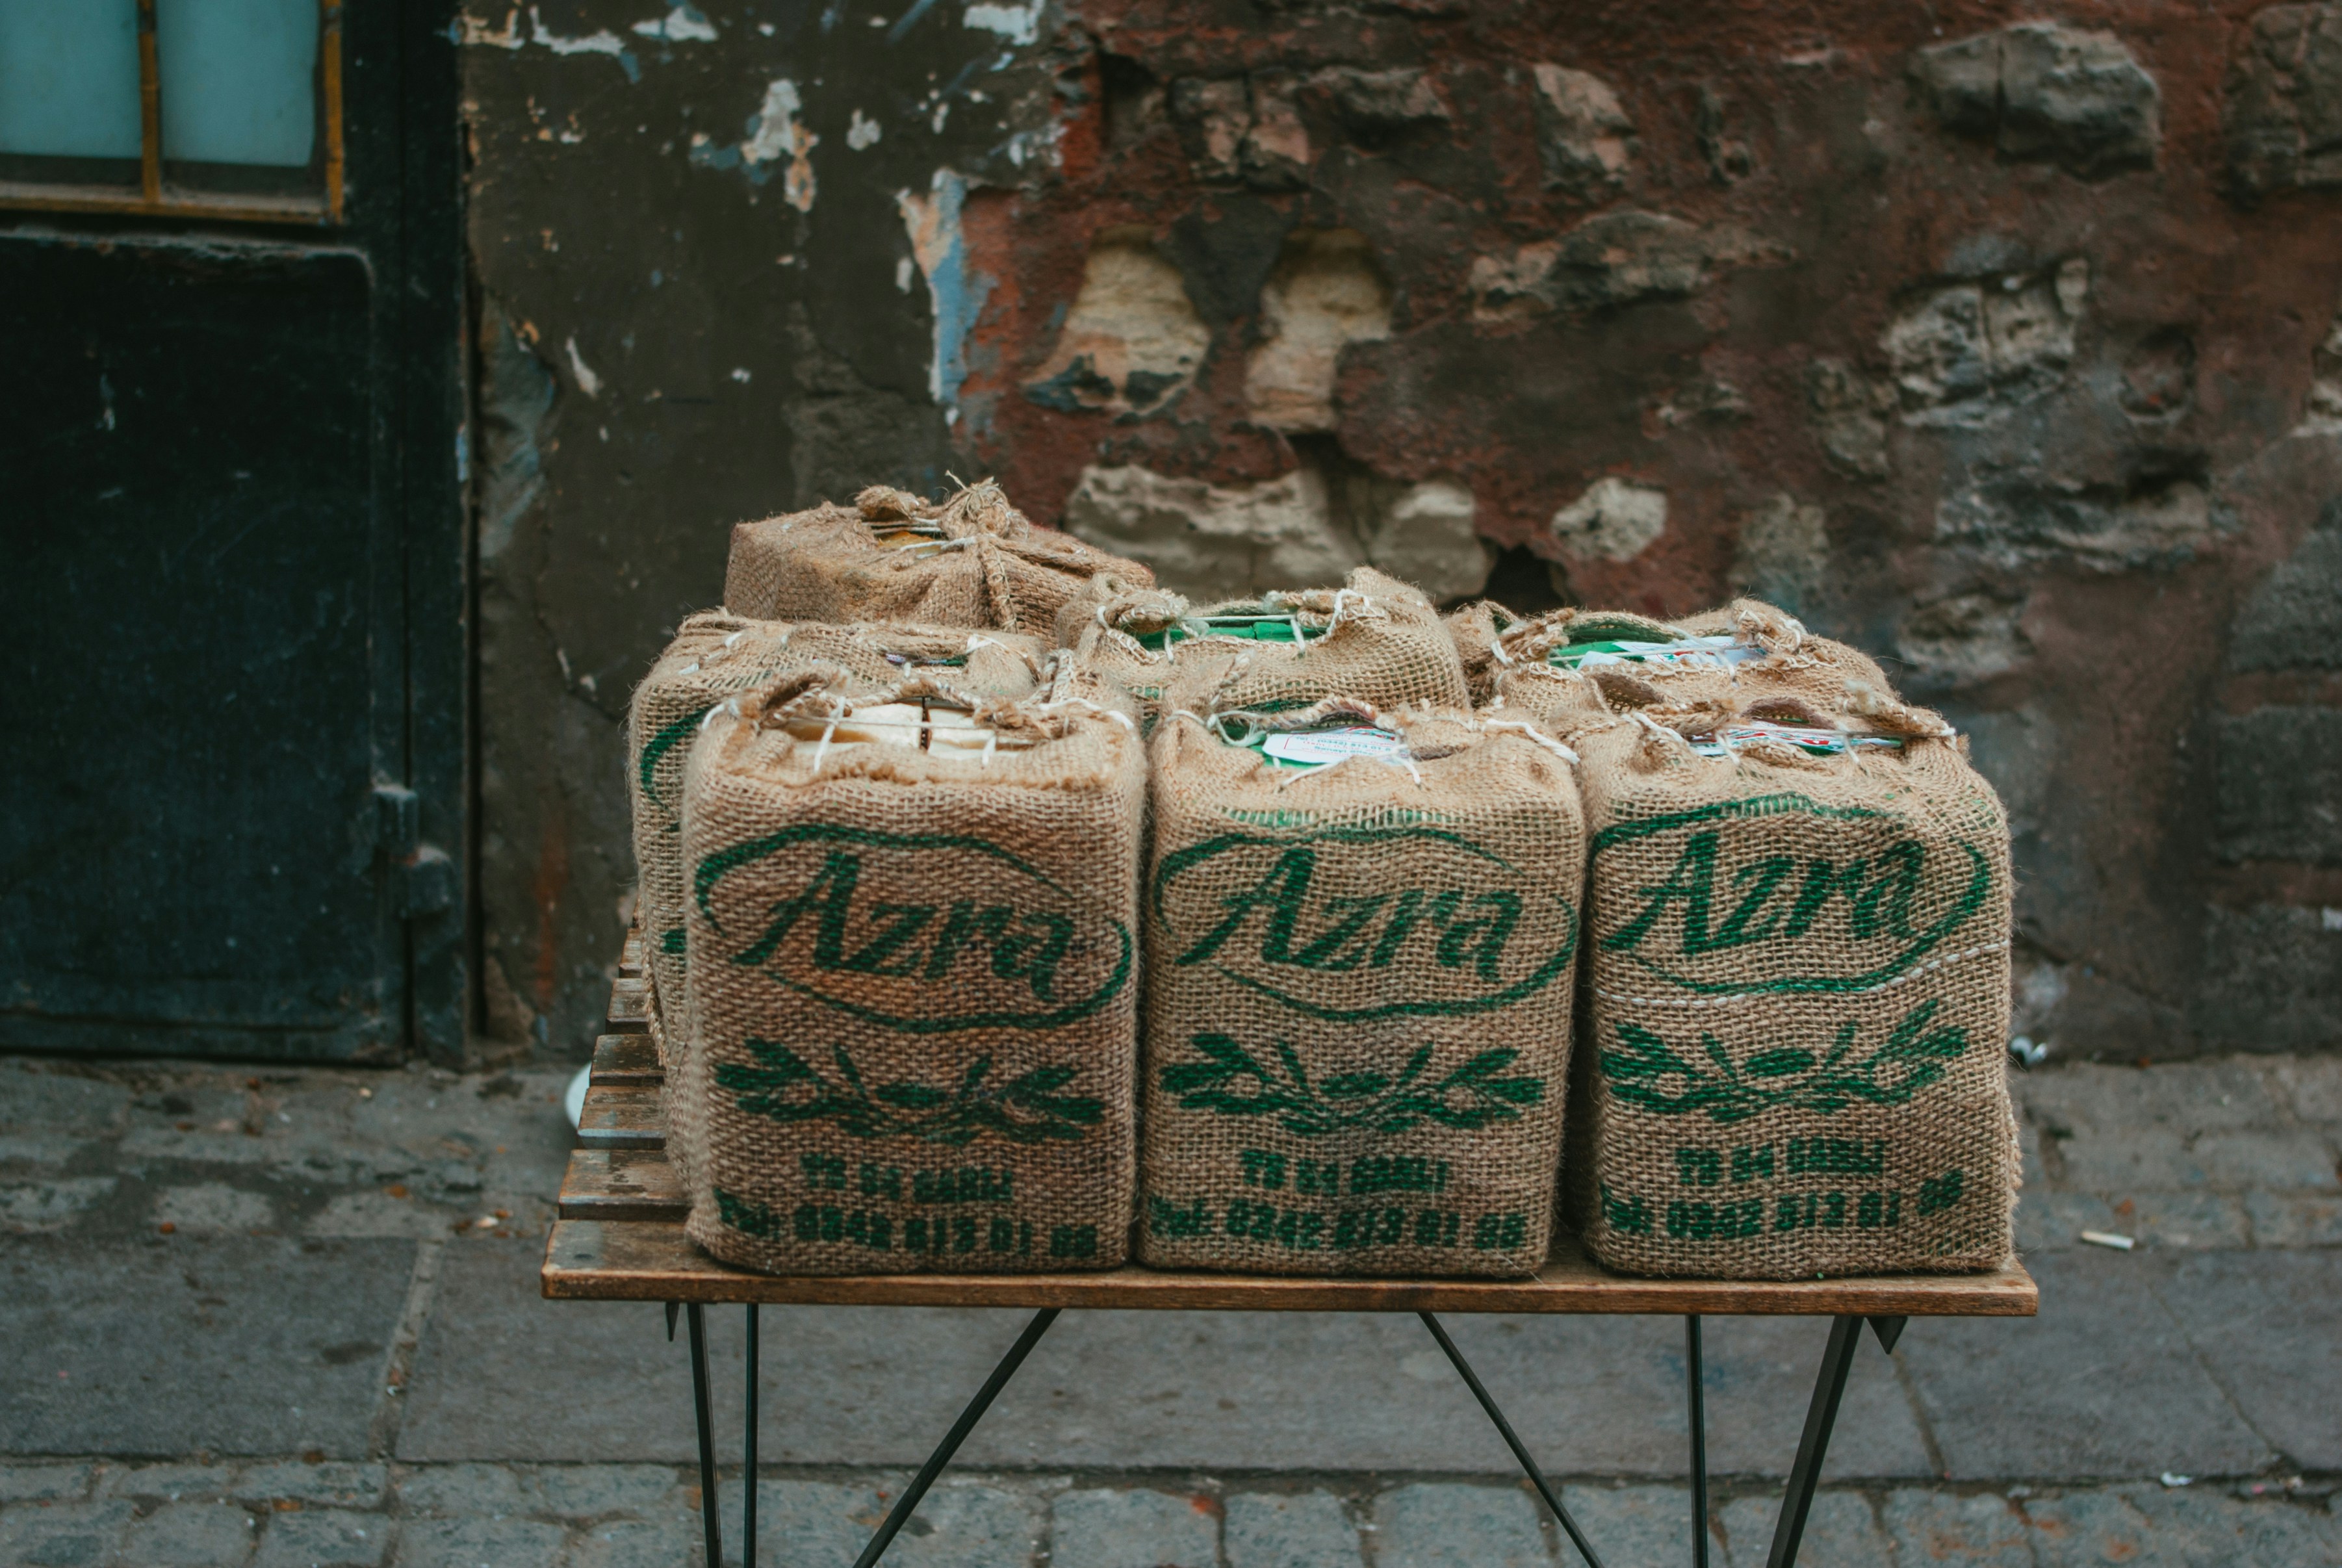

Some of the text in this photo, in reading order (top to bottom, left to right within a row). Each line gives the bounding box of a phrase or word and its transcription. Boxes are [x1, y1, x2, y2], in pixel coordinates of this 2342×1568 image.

[731, 849, 1075, 1002] Azra
[1175, 847, 1523, 983] Azra
[1601, 830, 1924, 956] Azra
